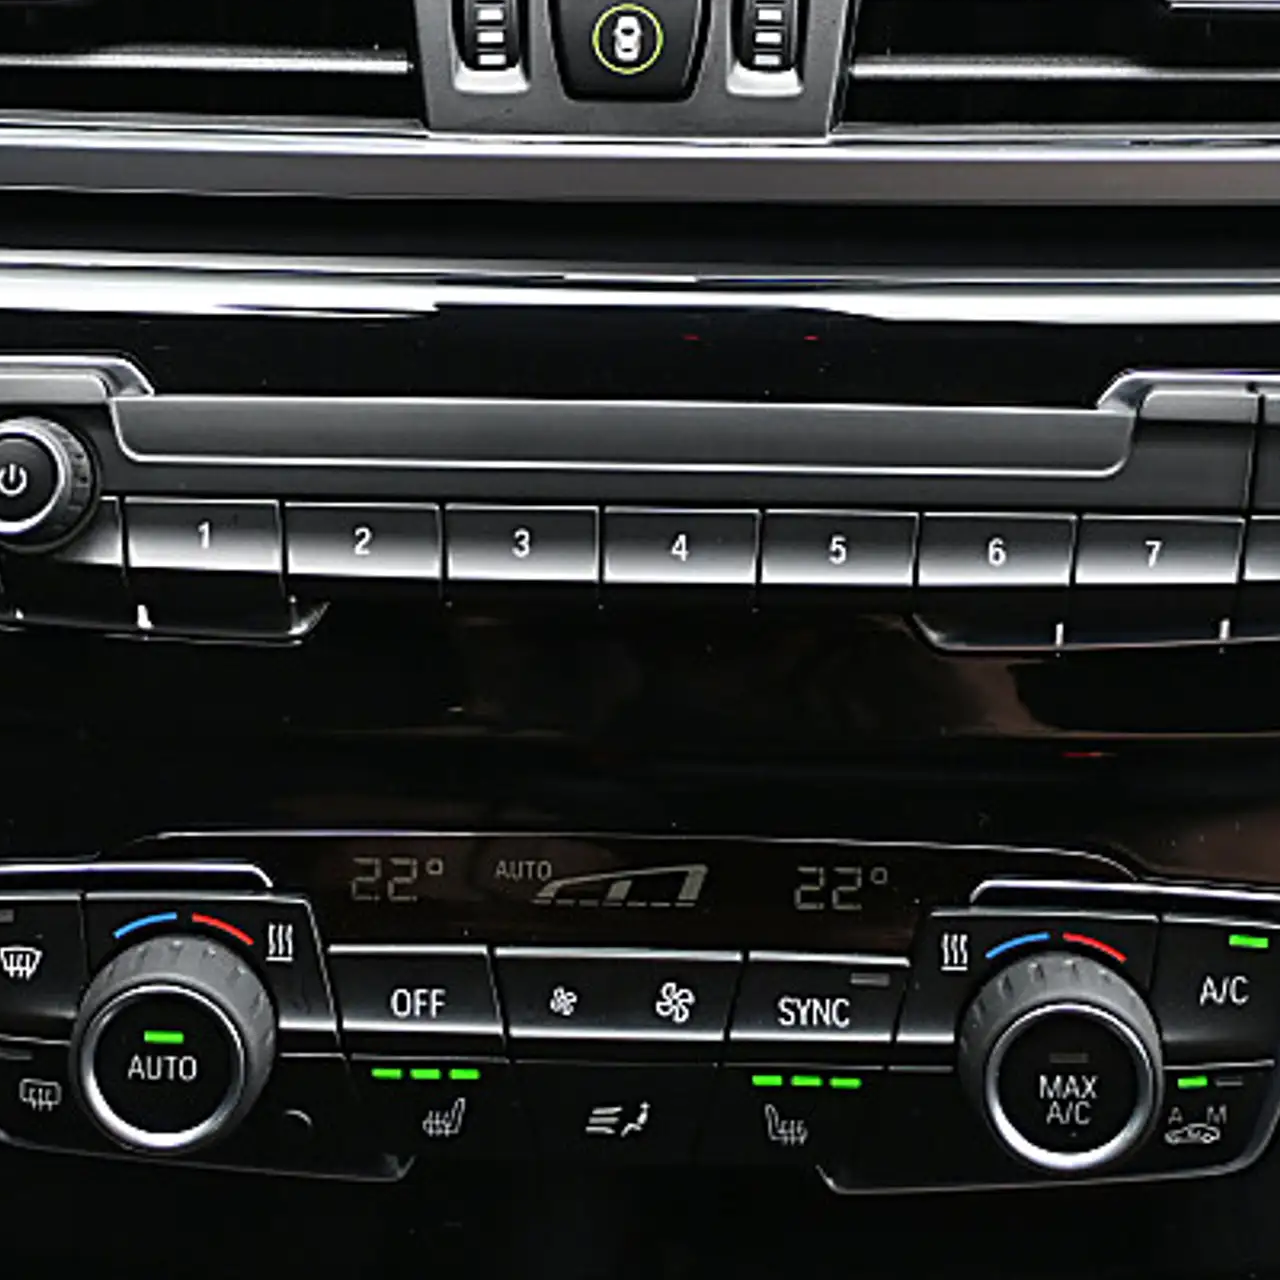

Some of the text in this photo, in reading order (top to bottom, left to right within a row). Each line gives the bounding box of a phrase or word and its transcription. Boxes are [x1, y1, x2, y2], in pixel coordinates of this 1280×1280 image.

[199, 523, 212, 549] 1
[355, 528, 371, 556] 2
[513, 529, 531, 557] 3
[671, 534, 689, 562] 4
[830, 537, 847, 565] 5
[988, 538, 1006, 565] 6
[1146, 539, 1161, 567] 7
[495, 859, 552, 882] AUTO
[391, 989, 446, 1017] OFF
[1199, 977, 1249, 1006] A/C
[778, 997, 851, 1028] SYNC
[127, 1055, 197, 1082] AUTO
[1039, 1074, 1097, 1100] MAX
[1046, 1100, 1091, 1126] A/C
[1167, 1106, 1228, 1124] A M
